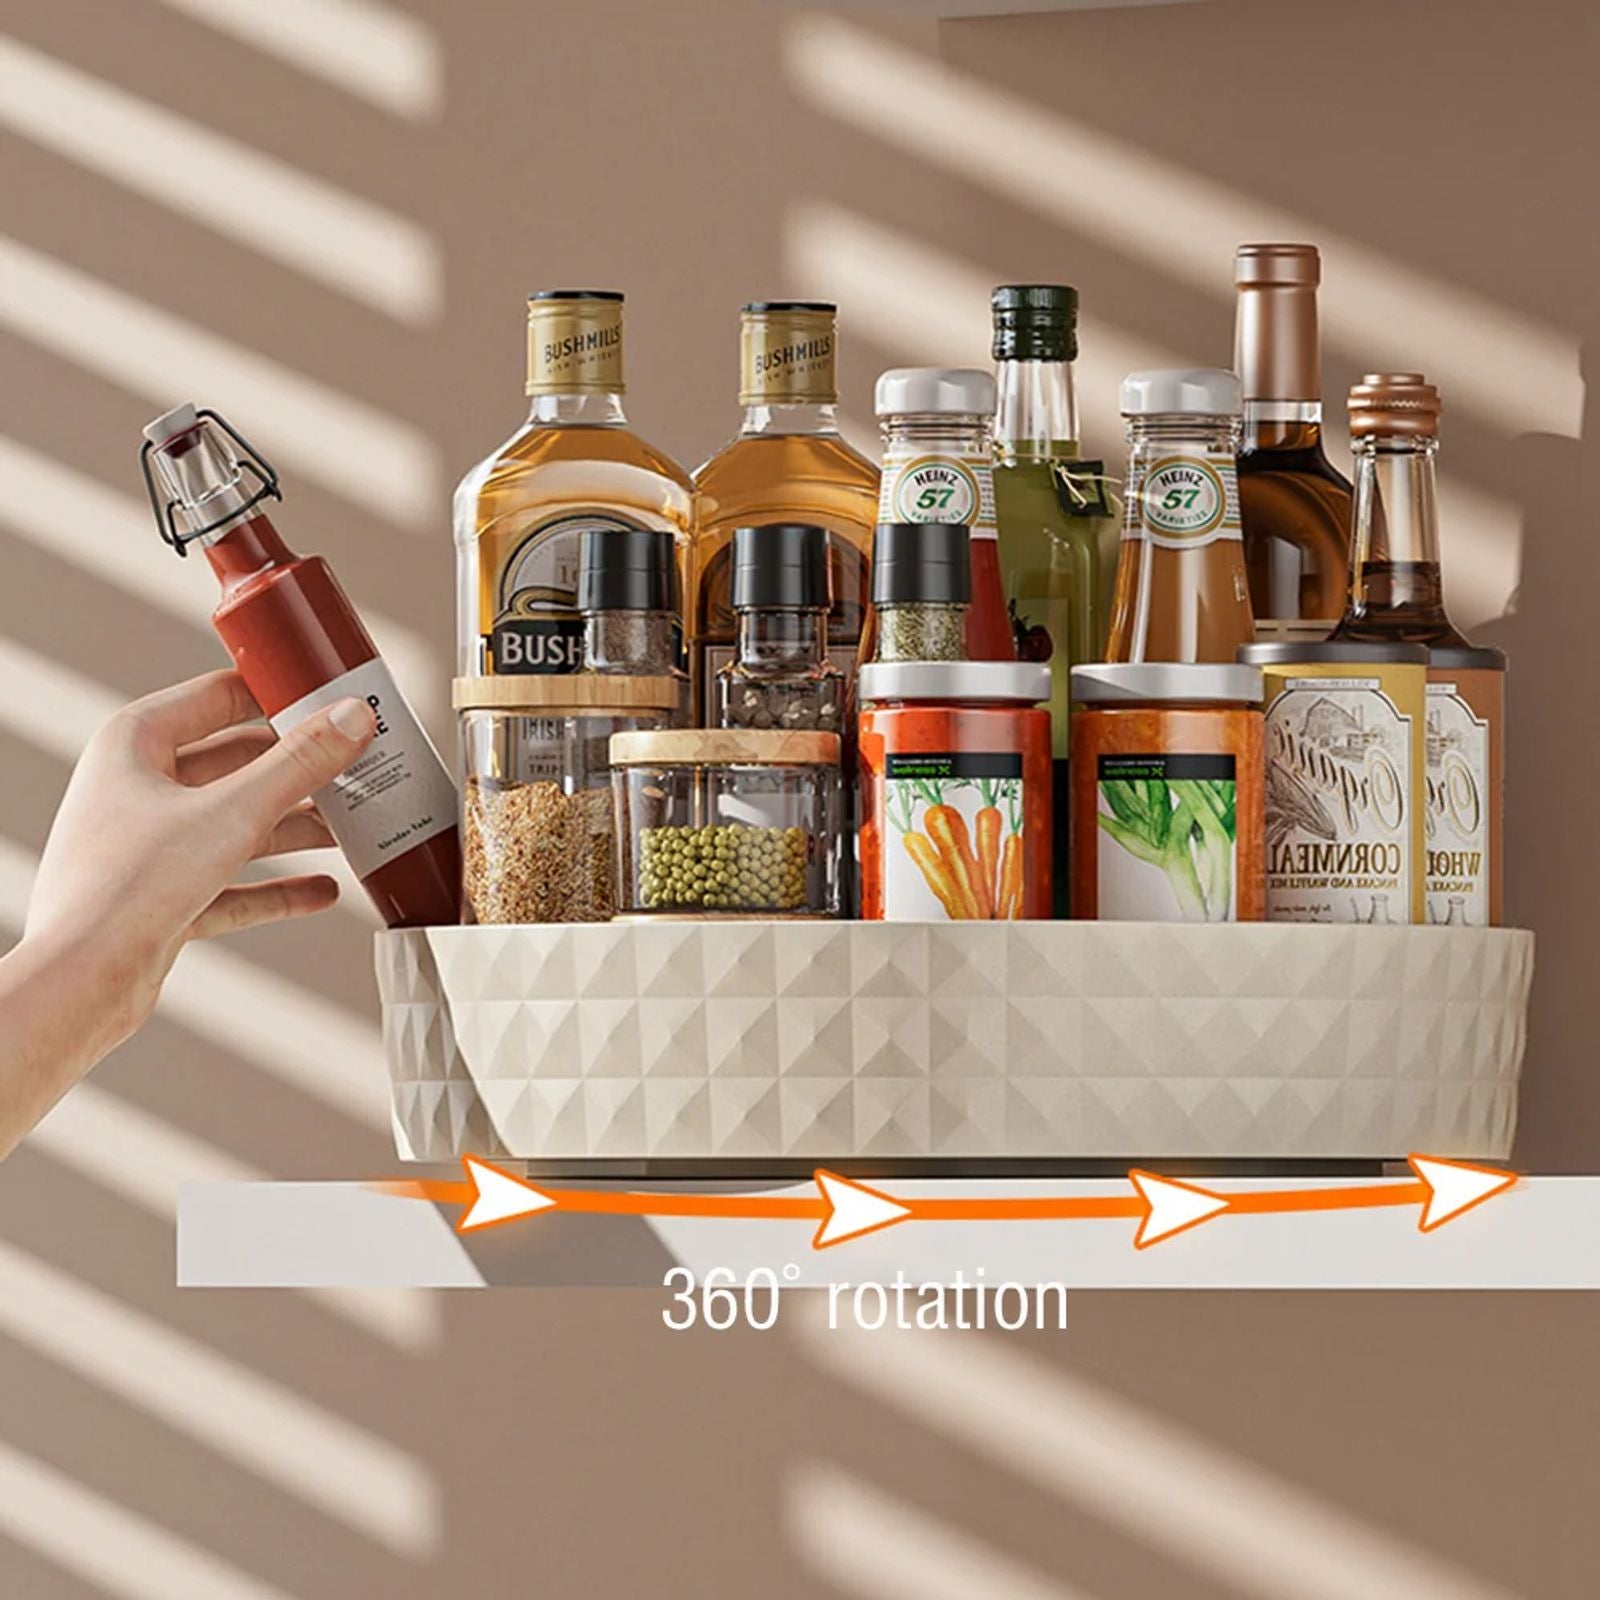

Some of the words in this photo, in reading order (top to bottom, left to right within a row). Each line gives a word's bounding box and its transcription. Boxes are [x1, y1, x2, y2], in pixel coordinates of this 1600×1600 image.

[544, 325, 620, 364] BUSHMILLS
[755, 336, 831, 375] BUSHMILLS
[914, 470, 959, 487] HEINZ
[1158, 469, 1204, 487] HEINZ
[916, 488, 955, 509] 57
[1161, 488, 1200, 509] 57
